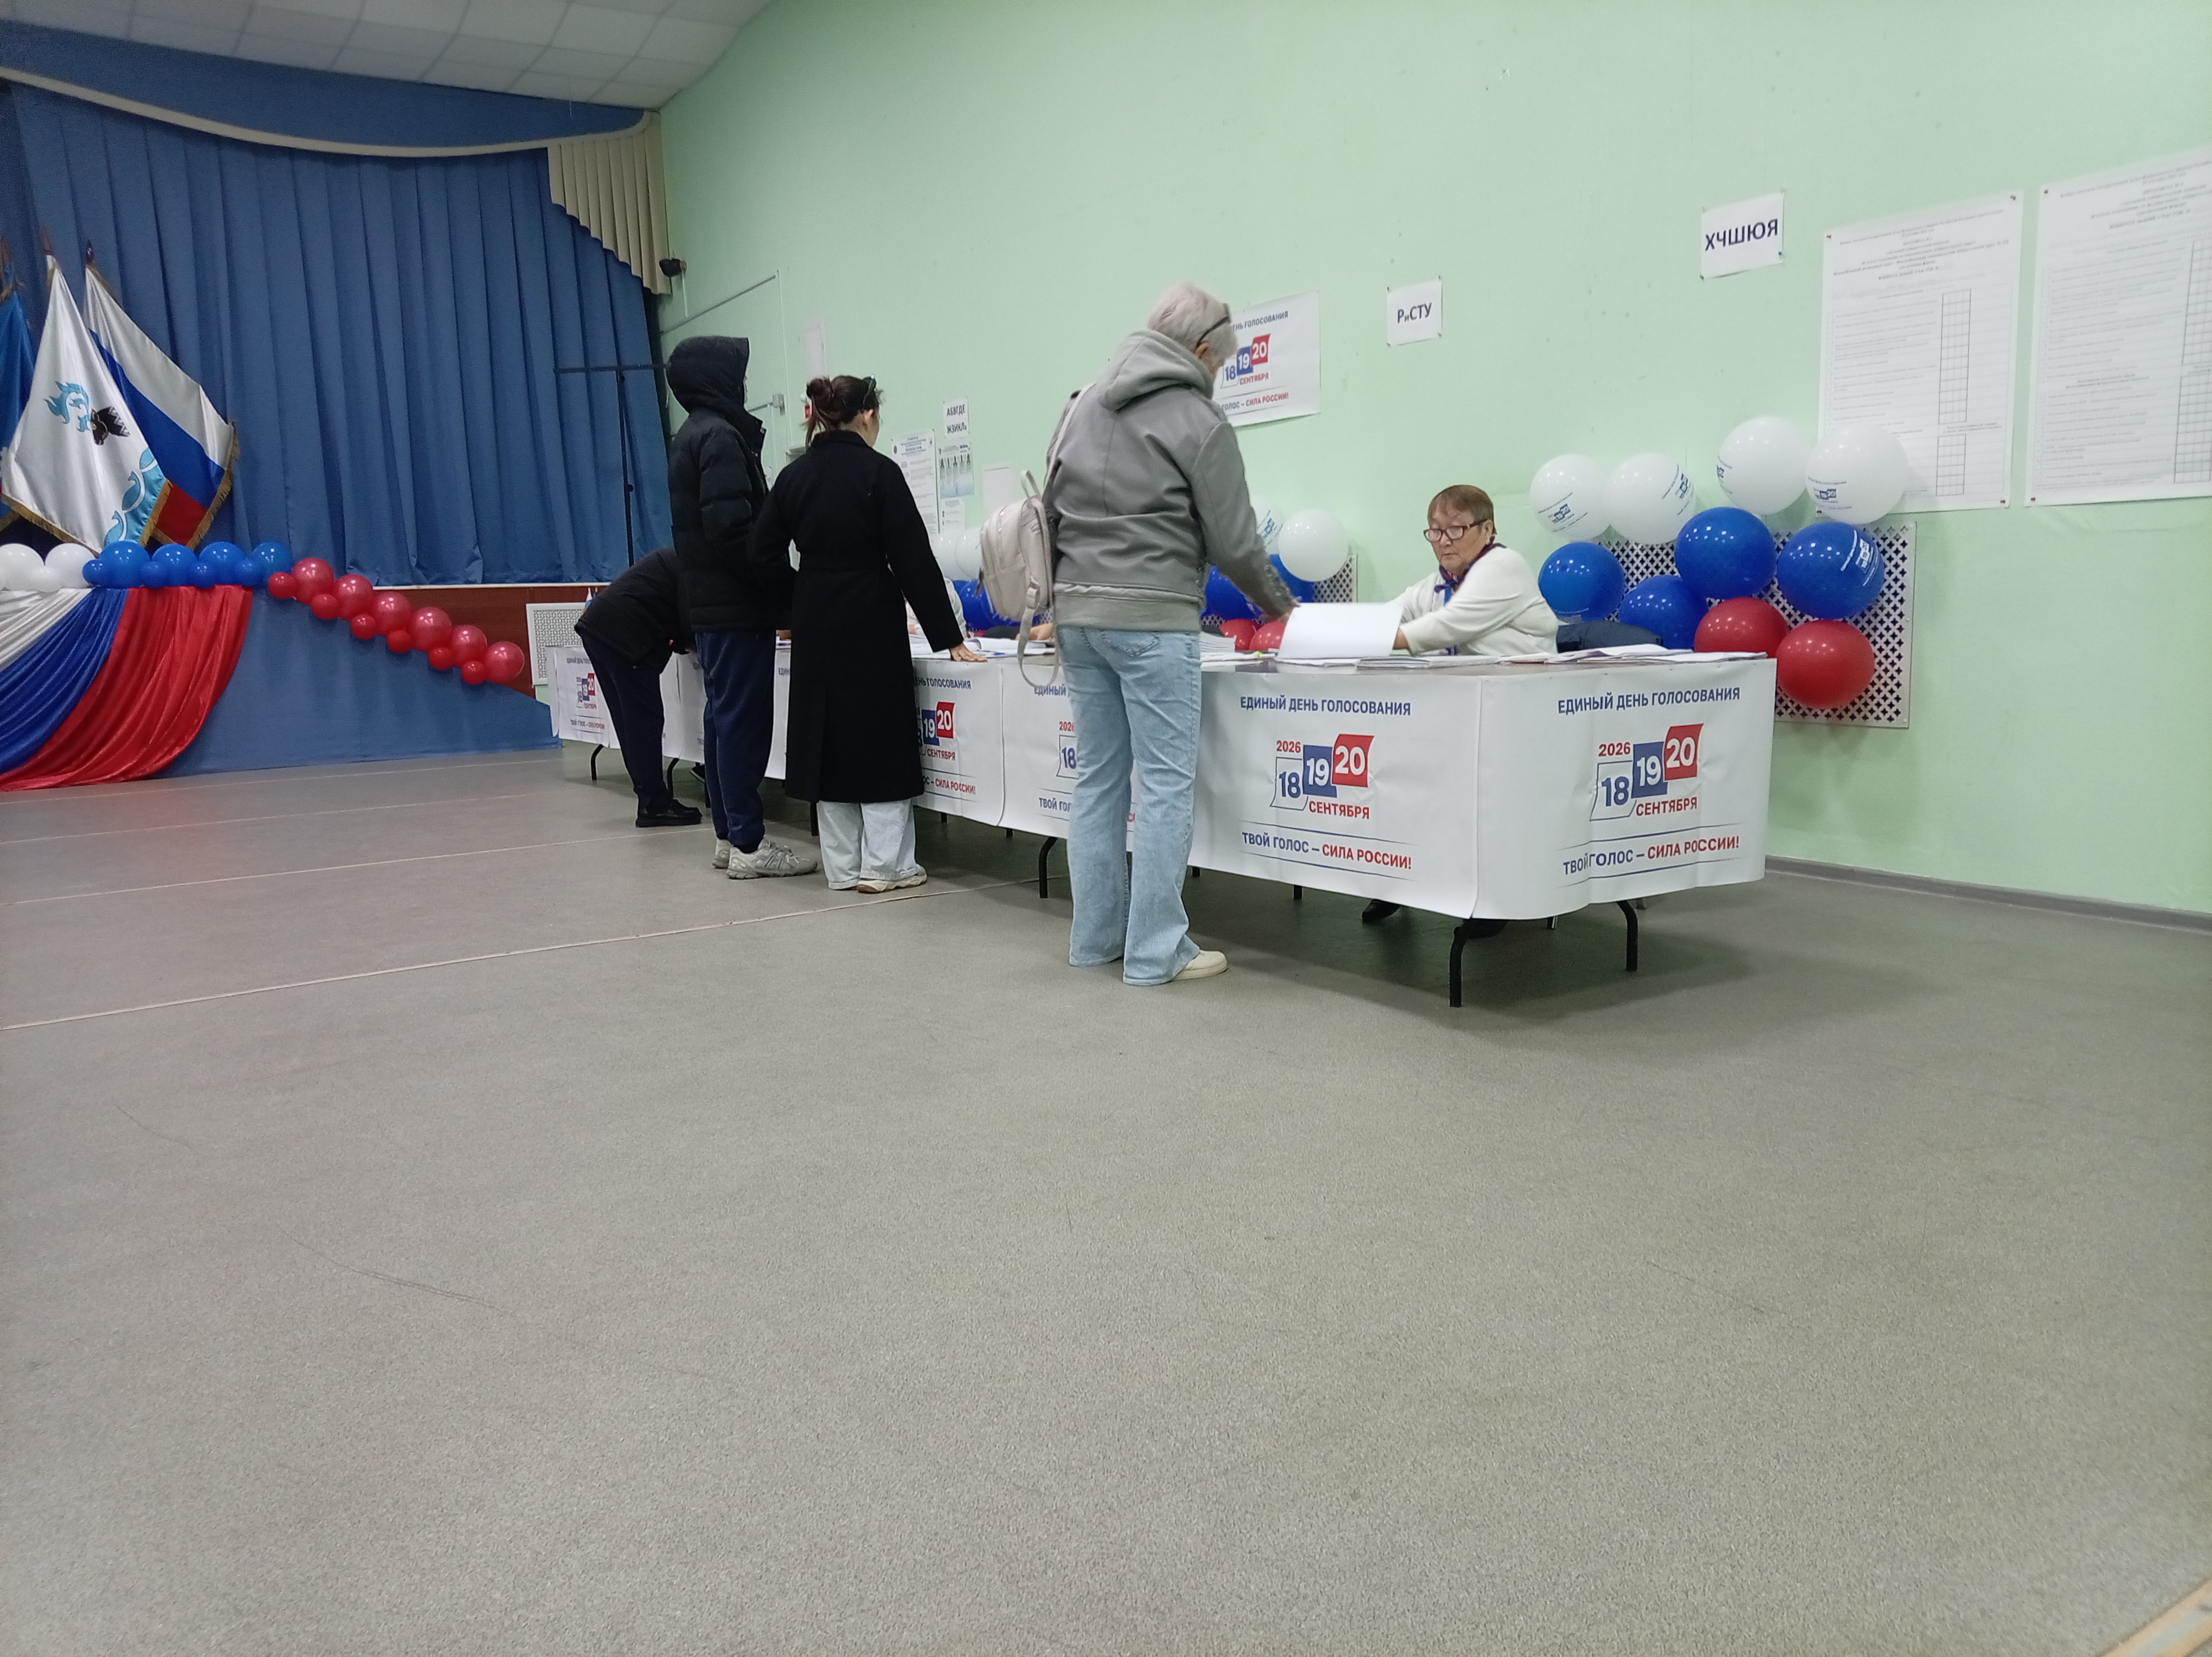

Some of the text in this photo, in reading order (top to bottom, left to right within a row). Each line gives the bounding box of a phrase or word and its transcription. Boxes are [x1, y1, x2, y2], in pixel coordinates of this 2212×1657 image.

[1705, 218, 1778, 252] ХЧШЮЯ
[1232, 311, 1289, 331] ЕНЬ ГОЛОСОВАНИЯ
[1252, 341, 1267, 361] 20
[1238, 352, 1250, 371] 19
[1224, 365, 1236, 381] 18
[1239, 372, 1269, 386] СЕНТЯБРЯ
[1246, 397, 1262, 407] СИЛА
[1262, 391, 1289, 404] РОССИИ!
[926, 677, 972, 690] ГОЛОСОВАНИЯ
[1033, 683, 1066, 697] ЕДИНЫЙ
[1240, 694, 1411, 716] ЕДИНЫЙ ДЕНЬ ГОЛОСОВАНИЯ
[1558, 686, 1740, 715] ЕДИНЫЙ ДЕНЬ ГОЛОСОВАНИЯ
[923, 718, 936, 739] 19
[936, 709, 952, 731] 20
[927, 748, 956, 761] СЕНТЯБРЯ
[1276, 740, 1301, 753] 2026
[1598, 741, 1631, 757] 2026
[1666, 736, 1696, 769] 20
[1061, 747, 1077, 769] 18
[1335, 745, 1366, 776] 20
[1306, 757, 1329, 786] 19
[1636, 755, 1662, 787] 19
[935, 778, 950, 790] СИЛА
[950, 781, 976, 795] РОССИИ!
[1278, 771, 1301, 799] 18
[1601, 776, 1630, 807] 18
[1039, 797, 1058, 811] ТВОЙ
[1308, 800, 1370, 820] СЕНТЯБРЯ
[1636, 797, 1698, 817] СЕНТЯБРЯ
[1242, 831, 1270, 847] ТВОЙ
[1273, 836, 1309, 853] ГОЛОС
[1322, 843, 1354, 860] СИЛА
[1357, 849, 1412, 870] РОССИИ!
[1563, 852, 1589, 875] ТВОЙ
[1589, 849, 1634, 868] ГОЛОС
[1647, 842, 1681, 859] СИЛА
[1684, 836, 1740, 854] РОССИИ!
